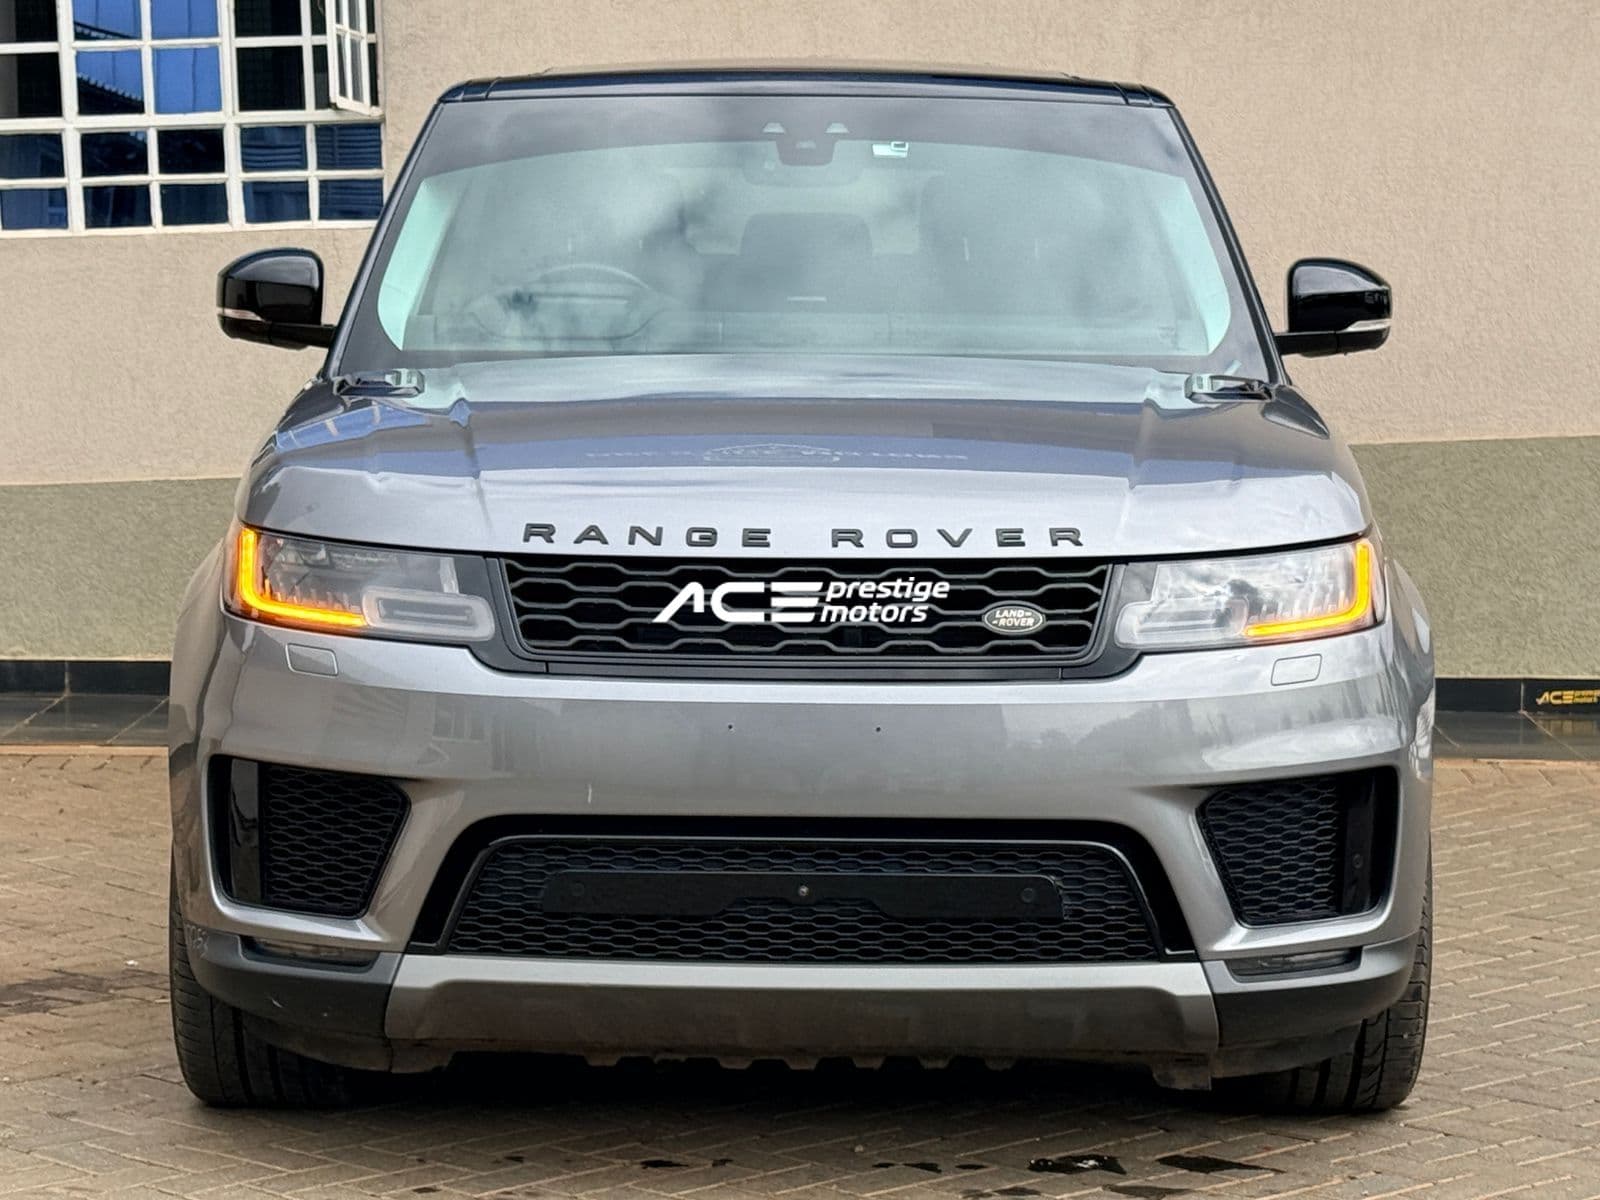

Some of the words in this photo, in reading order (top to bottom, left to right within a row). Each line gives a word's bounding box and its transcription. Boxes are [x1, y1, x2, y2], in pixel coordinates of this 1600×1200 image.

[523, 523, 771, 548] RANGE
[831, 527, 1084, 549] ROVER
[1536, 690, 1574, 705] ACE
